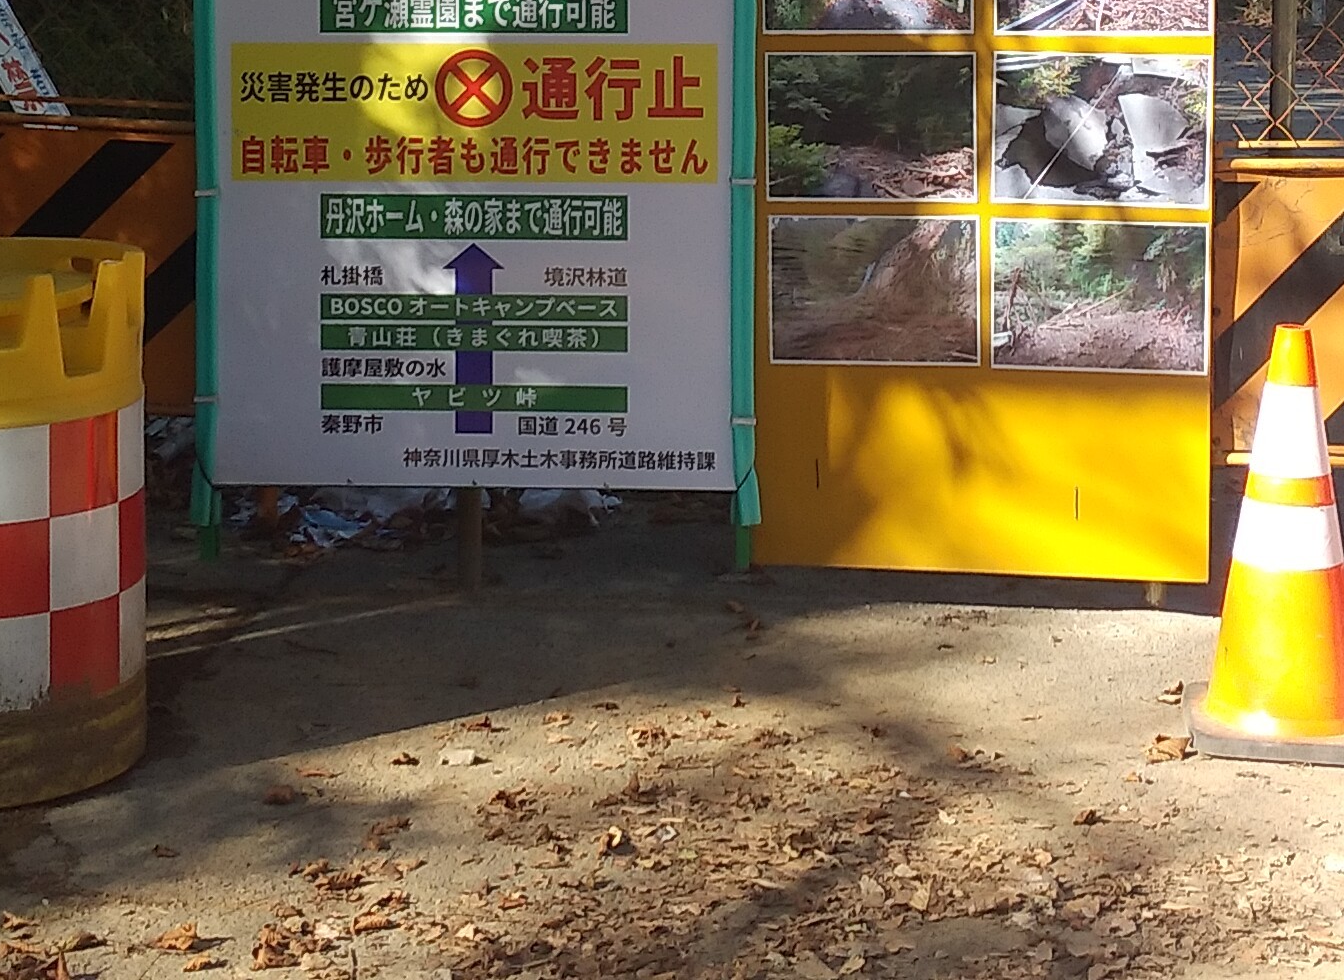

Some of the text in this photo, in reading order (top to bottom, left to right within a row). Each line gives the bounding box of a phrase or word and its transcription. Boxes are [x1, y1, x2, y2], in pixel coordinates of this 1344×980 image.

[239, 72, 430, 103] 災害発生のため
[522, 55, 705, 122] 通行止
[240, 135, 710, 176] 自転車・歩行者も通行できません
[325, 198, 623, 237] 丹沢ホーム・森の家まで通行可能
[319, 265, 384, 287] 札掛橋
[544, 267, 628, 288] 境沢林道
[330, 297, 618, 318] BOSCO オートキャンプベース
[320, 357, 447, 378] 護摩屋敷の水
[411, 387, 538, 408] ヤビツ峠
[320, 414, 384, 436] 秦野市
[402, 448, 717, 472] 神奈川県厚木土木事務所道路維持課
